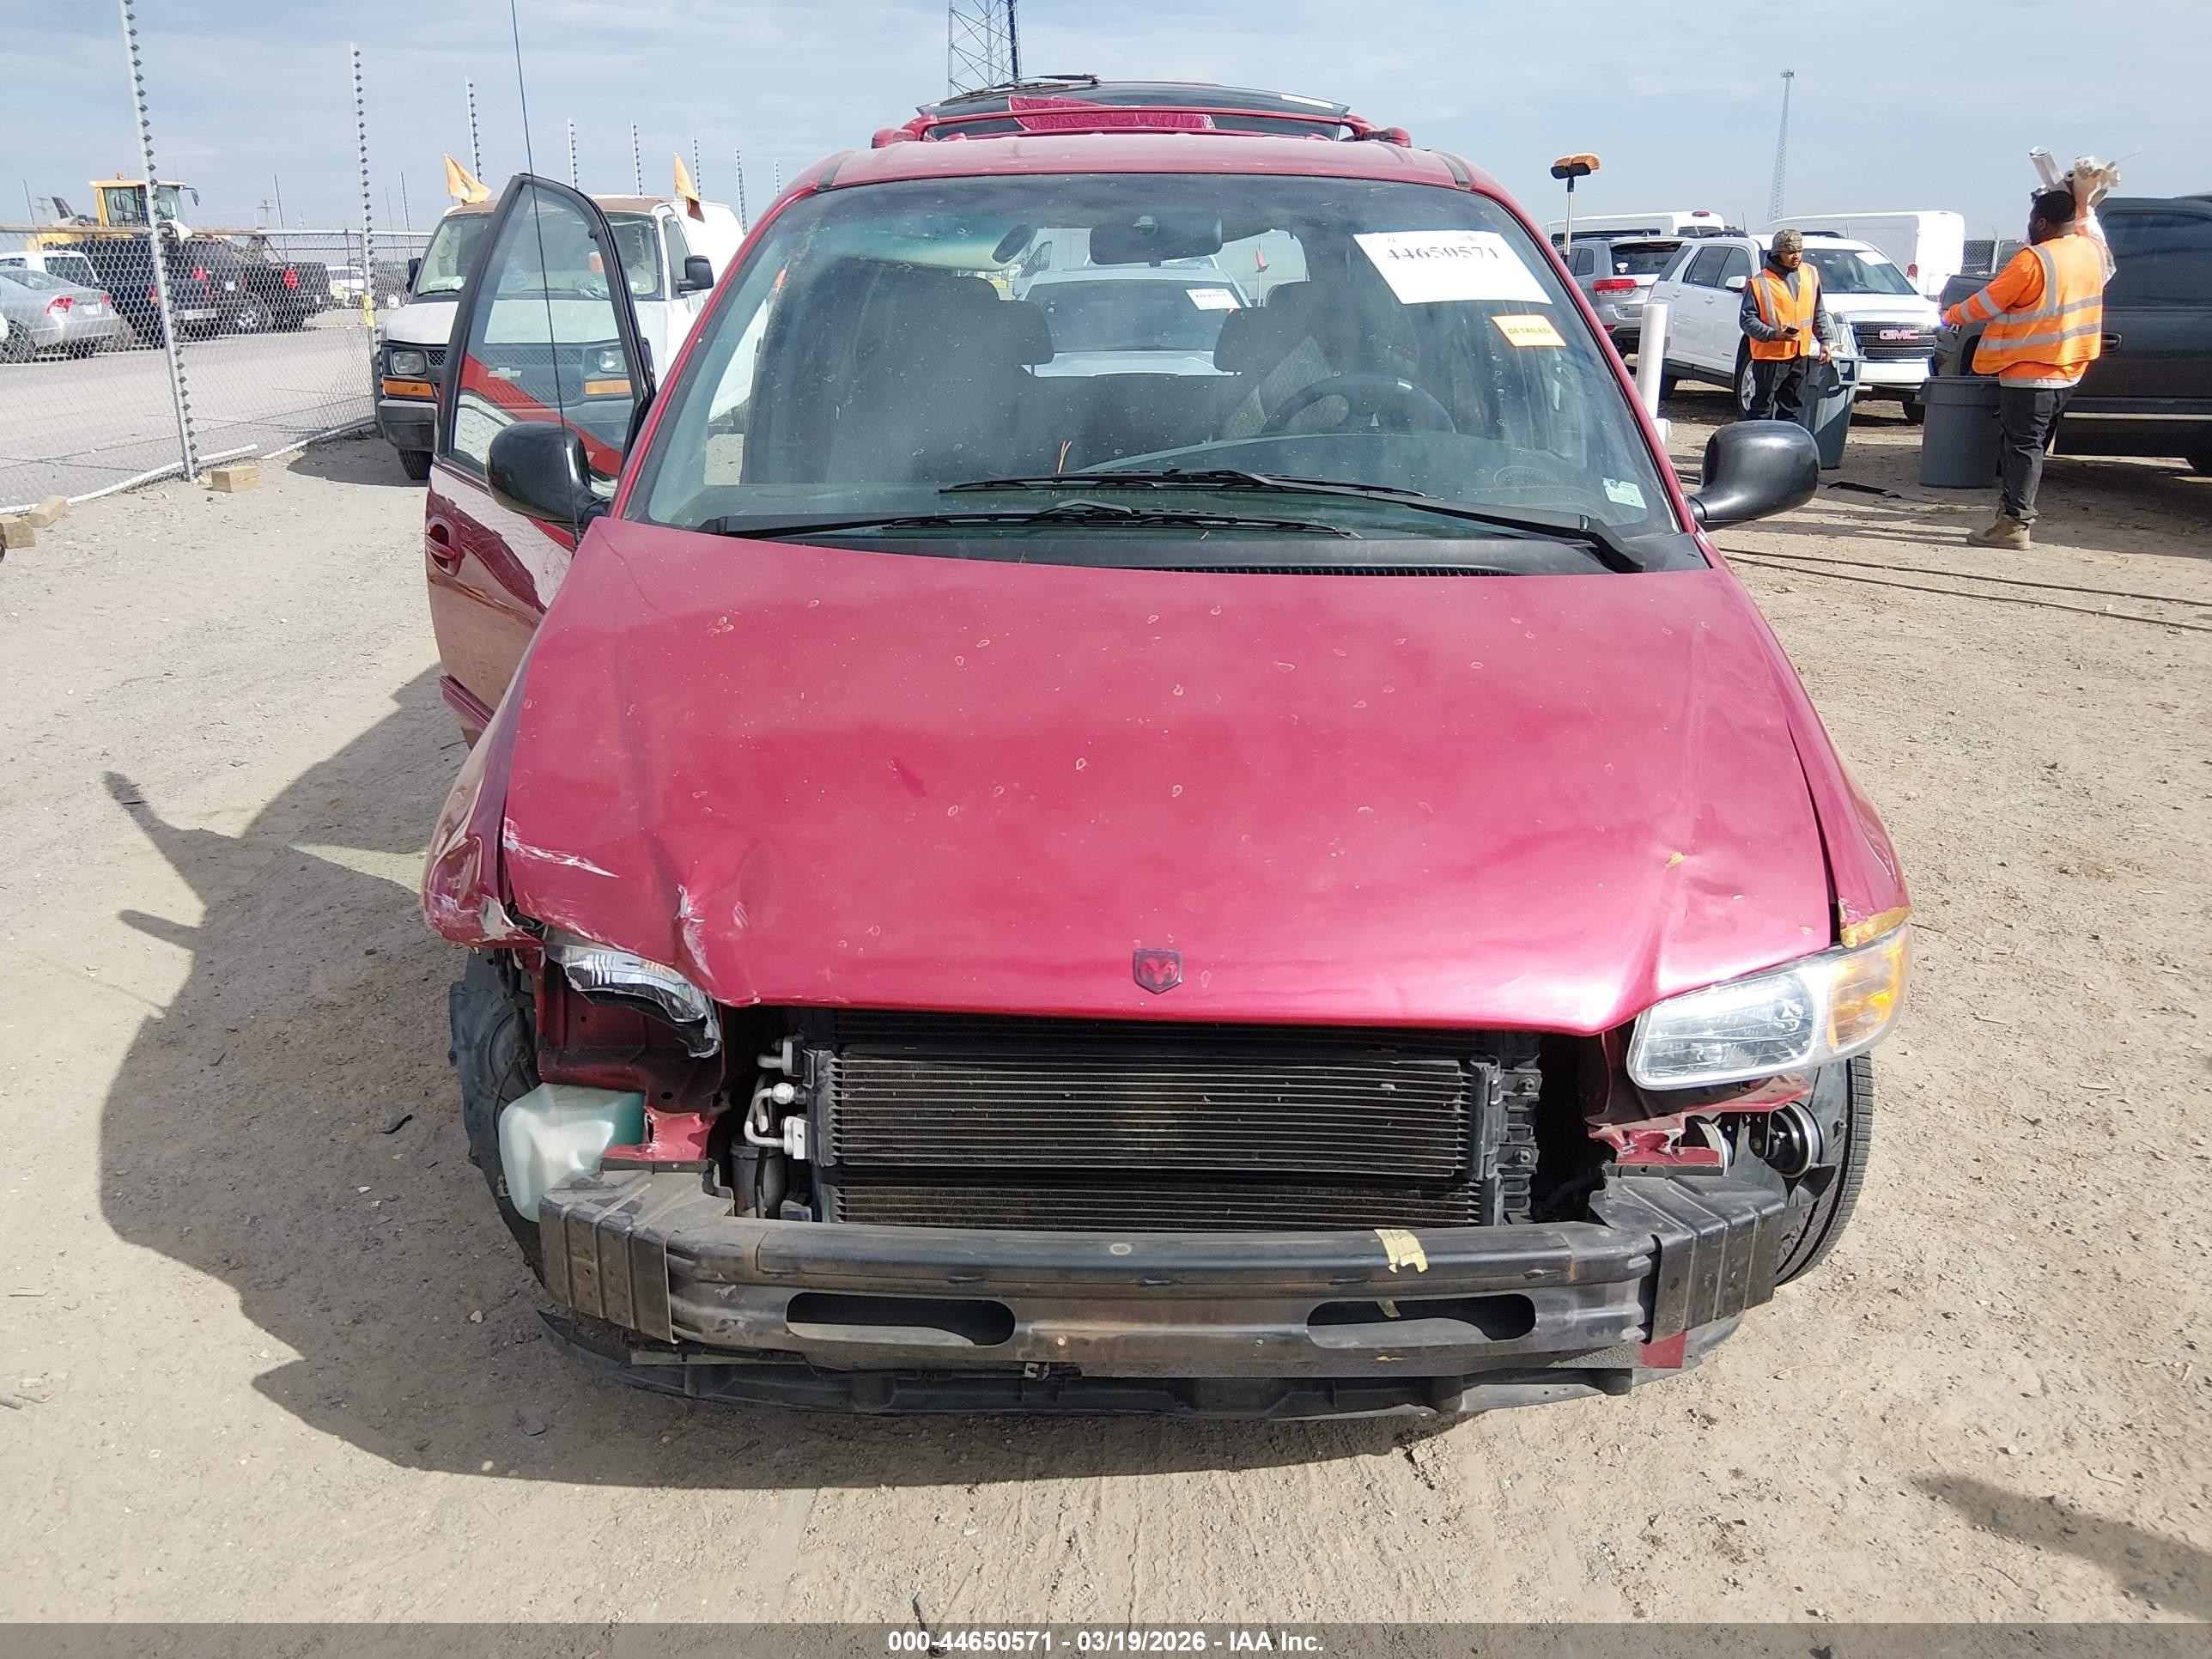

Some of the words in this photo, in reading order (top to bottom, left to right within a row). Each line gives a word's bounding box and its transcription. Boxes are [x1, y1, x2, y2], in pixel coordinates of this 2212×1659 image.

[1387, 246, 1499, 261] 44650571
[1507, 326, 1551, 335] DETAILED
[1879, 329, 1919, 340] GMC
